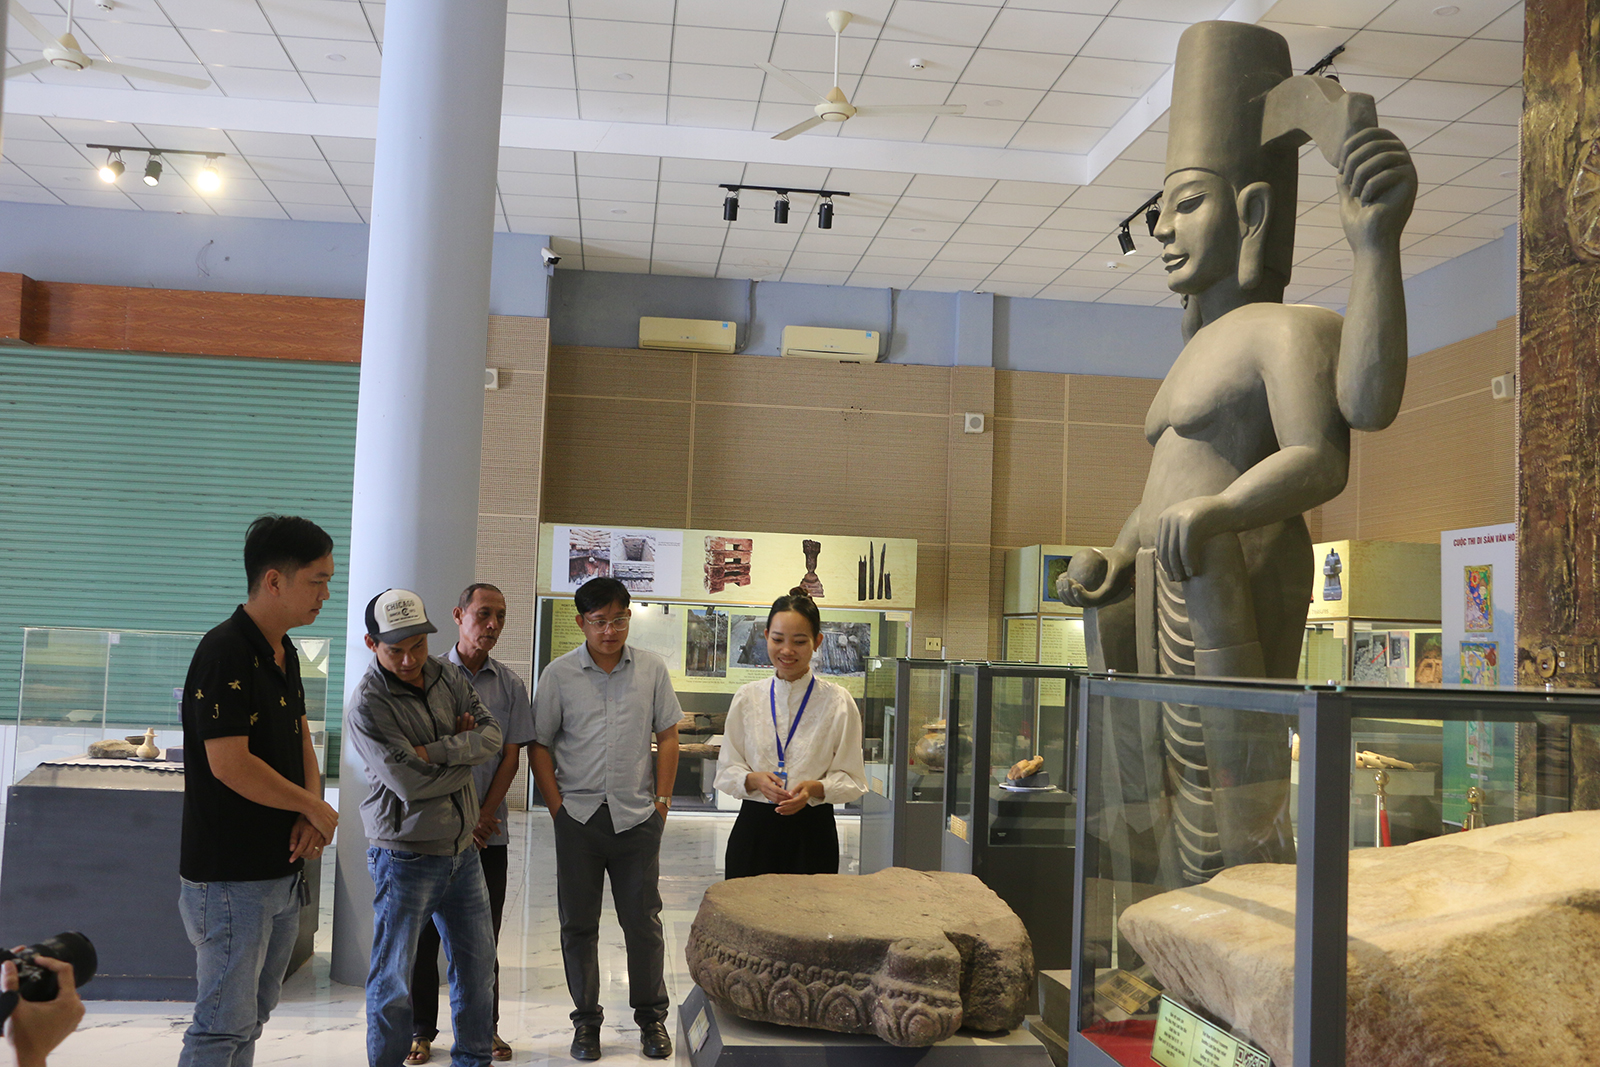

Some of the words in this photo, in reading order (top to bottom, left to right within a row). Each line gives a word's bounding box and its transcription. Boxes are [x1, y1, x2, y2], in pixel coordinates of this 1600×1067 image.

[1468, 537, 1476, 545] THI
[1483, 534, 1494, 544] SẢN
[1495, 533, 1507, 542] VĂN
[386, 600, 415, 611] CHICAGO
